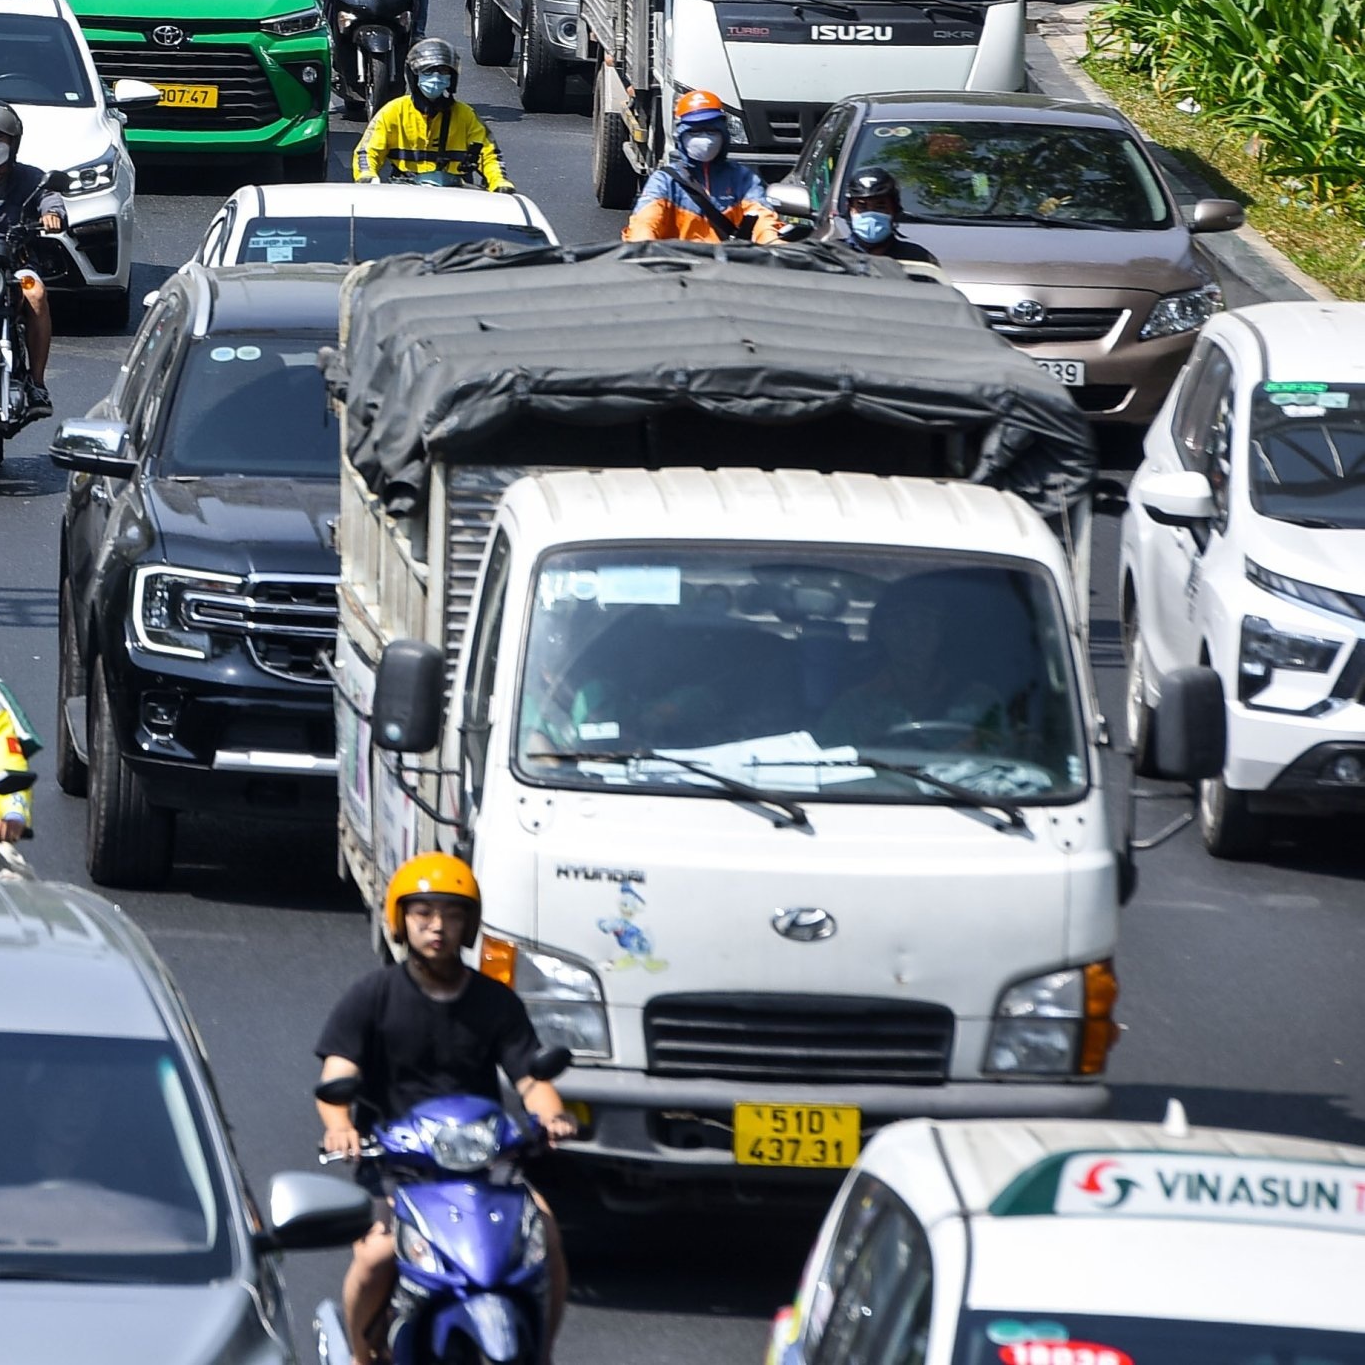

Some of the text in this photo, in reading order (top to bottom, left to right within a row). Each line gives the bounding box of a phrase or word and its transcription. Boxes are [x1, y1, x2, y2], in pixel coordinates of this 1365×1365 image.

[726, 24, 976, 42] TURBO ISUZU QKR
[556, 864, 647, 884] HYUNDAI
[772, 1109, 825, 1135] 51D
[749, 1138, 844, 1163] 437.31
[1156, 1168, 1340, 1212] VINASUN
